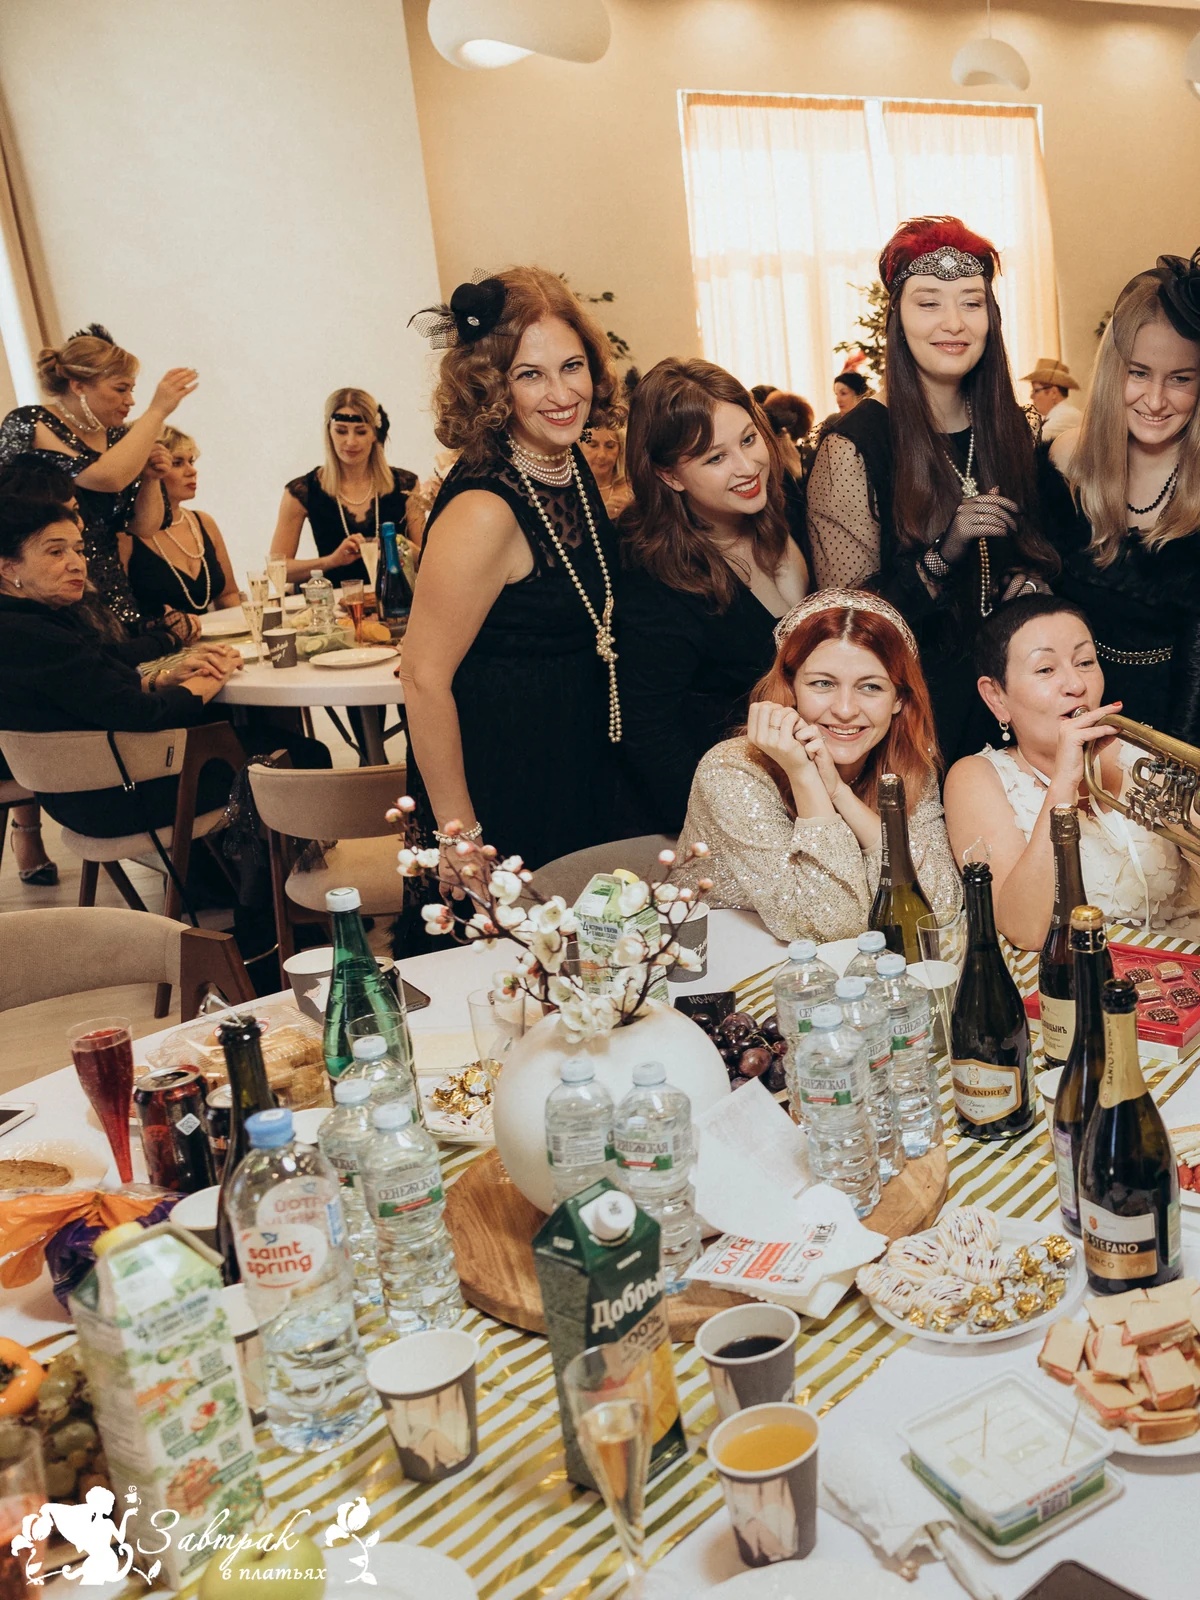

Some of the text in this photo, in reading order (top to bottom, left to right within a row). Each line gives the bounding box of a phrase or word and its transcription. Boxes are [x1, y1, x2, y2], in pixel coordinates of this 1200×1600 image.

[972, 1087, 1010, 1097] ANDREA
[248, 1241, 302, 1260] saint
[1090, 1234, 1139, 1254] STEFANO
[246, 1255, 312, 1279] spring
[591, 1271, 666, 1334] Добры
